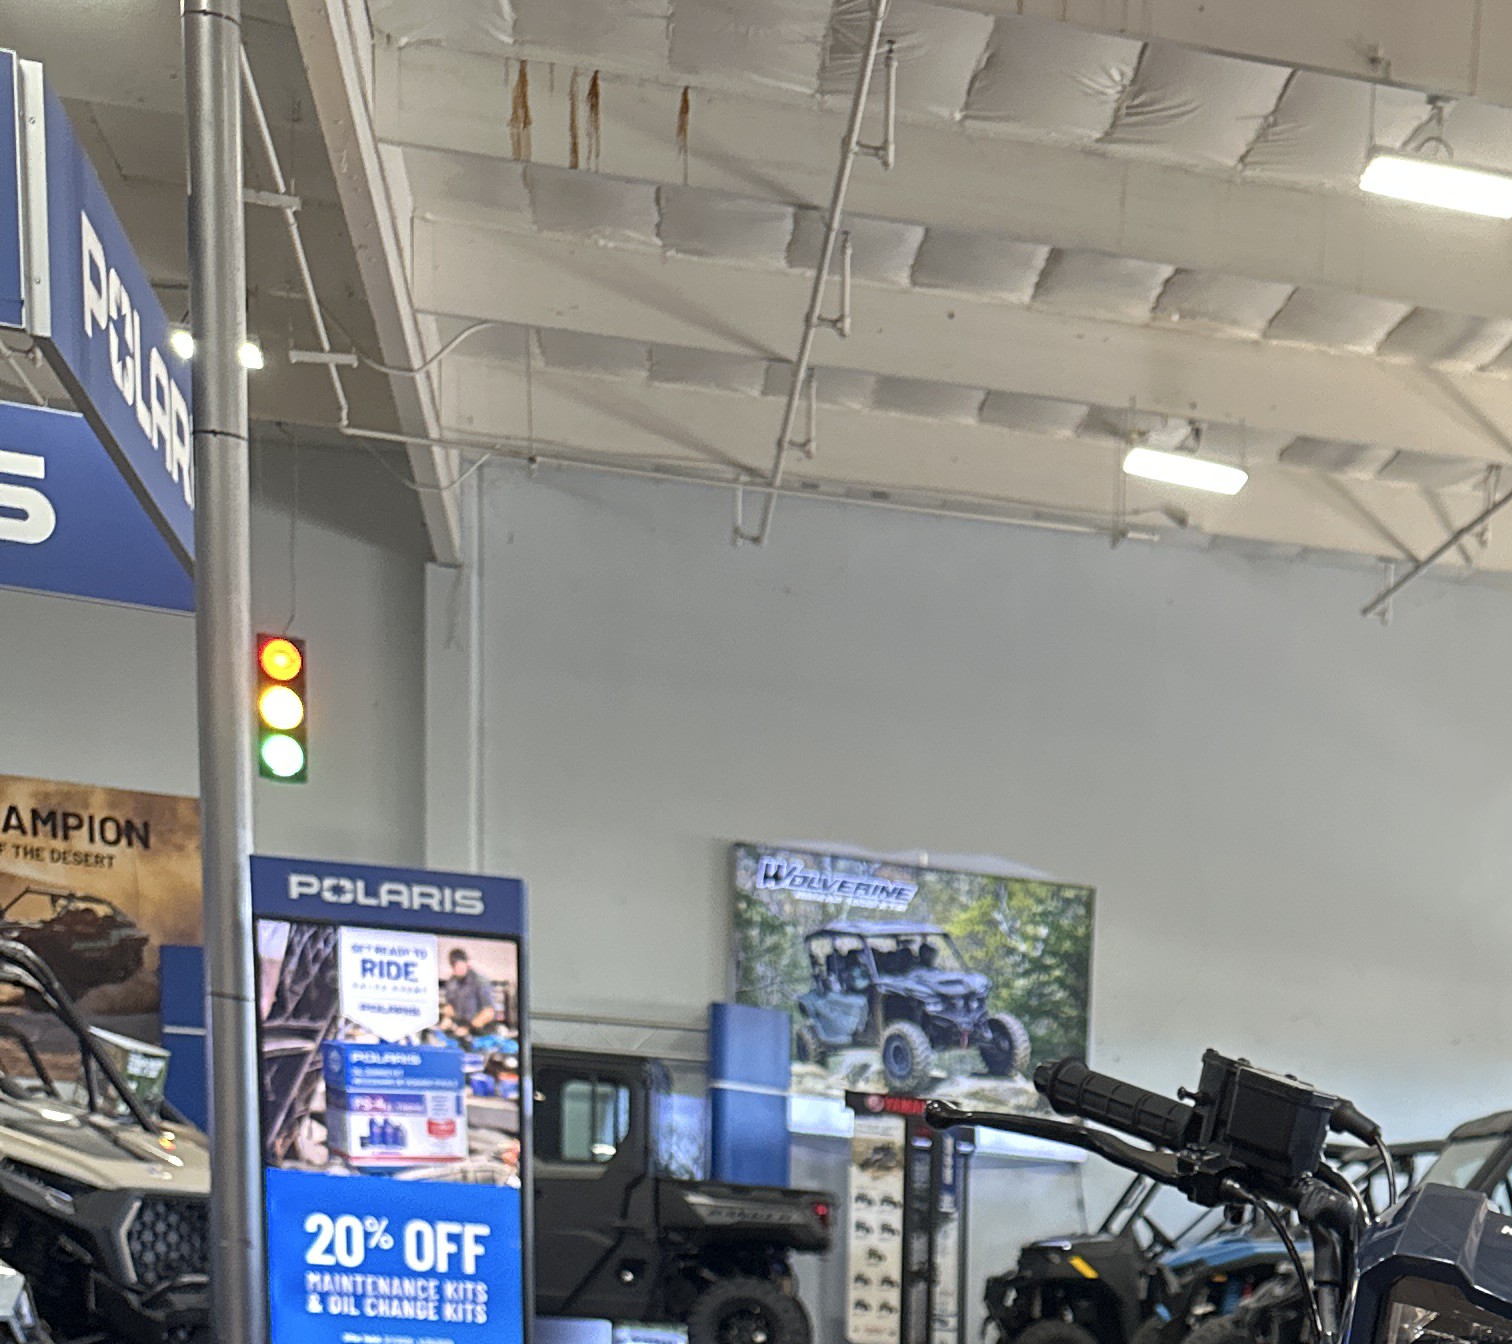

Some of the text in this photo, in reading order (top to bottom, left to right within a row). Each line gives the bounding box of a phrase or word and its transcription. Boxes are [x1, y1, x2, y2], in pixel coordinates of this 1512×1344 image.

[11, 843, 46, 862] THE
[50, 847, 116, 870] DESERT
[288, 873, 485, 916] POLARIS
[361, 958, 419, 983] RIDE
[304, 1212, 491, 1275] 20% OFF
[305, 1271, 488, 1304] MAINTENANCE KITS
[306, 1293, 488, 1325] & OIL CHANGE KITS
